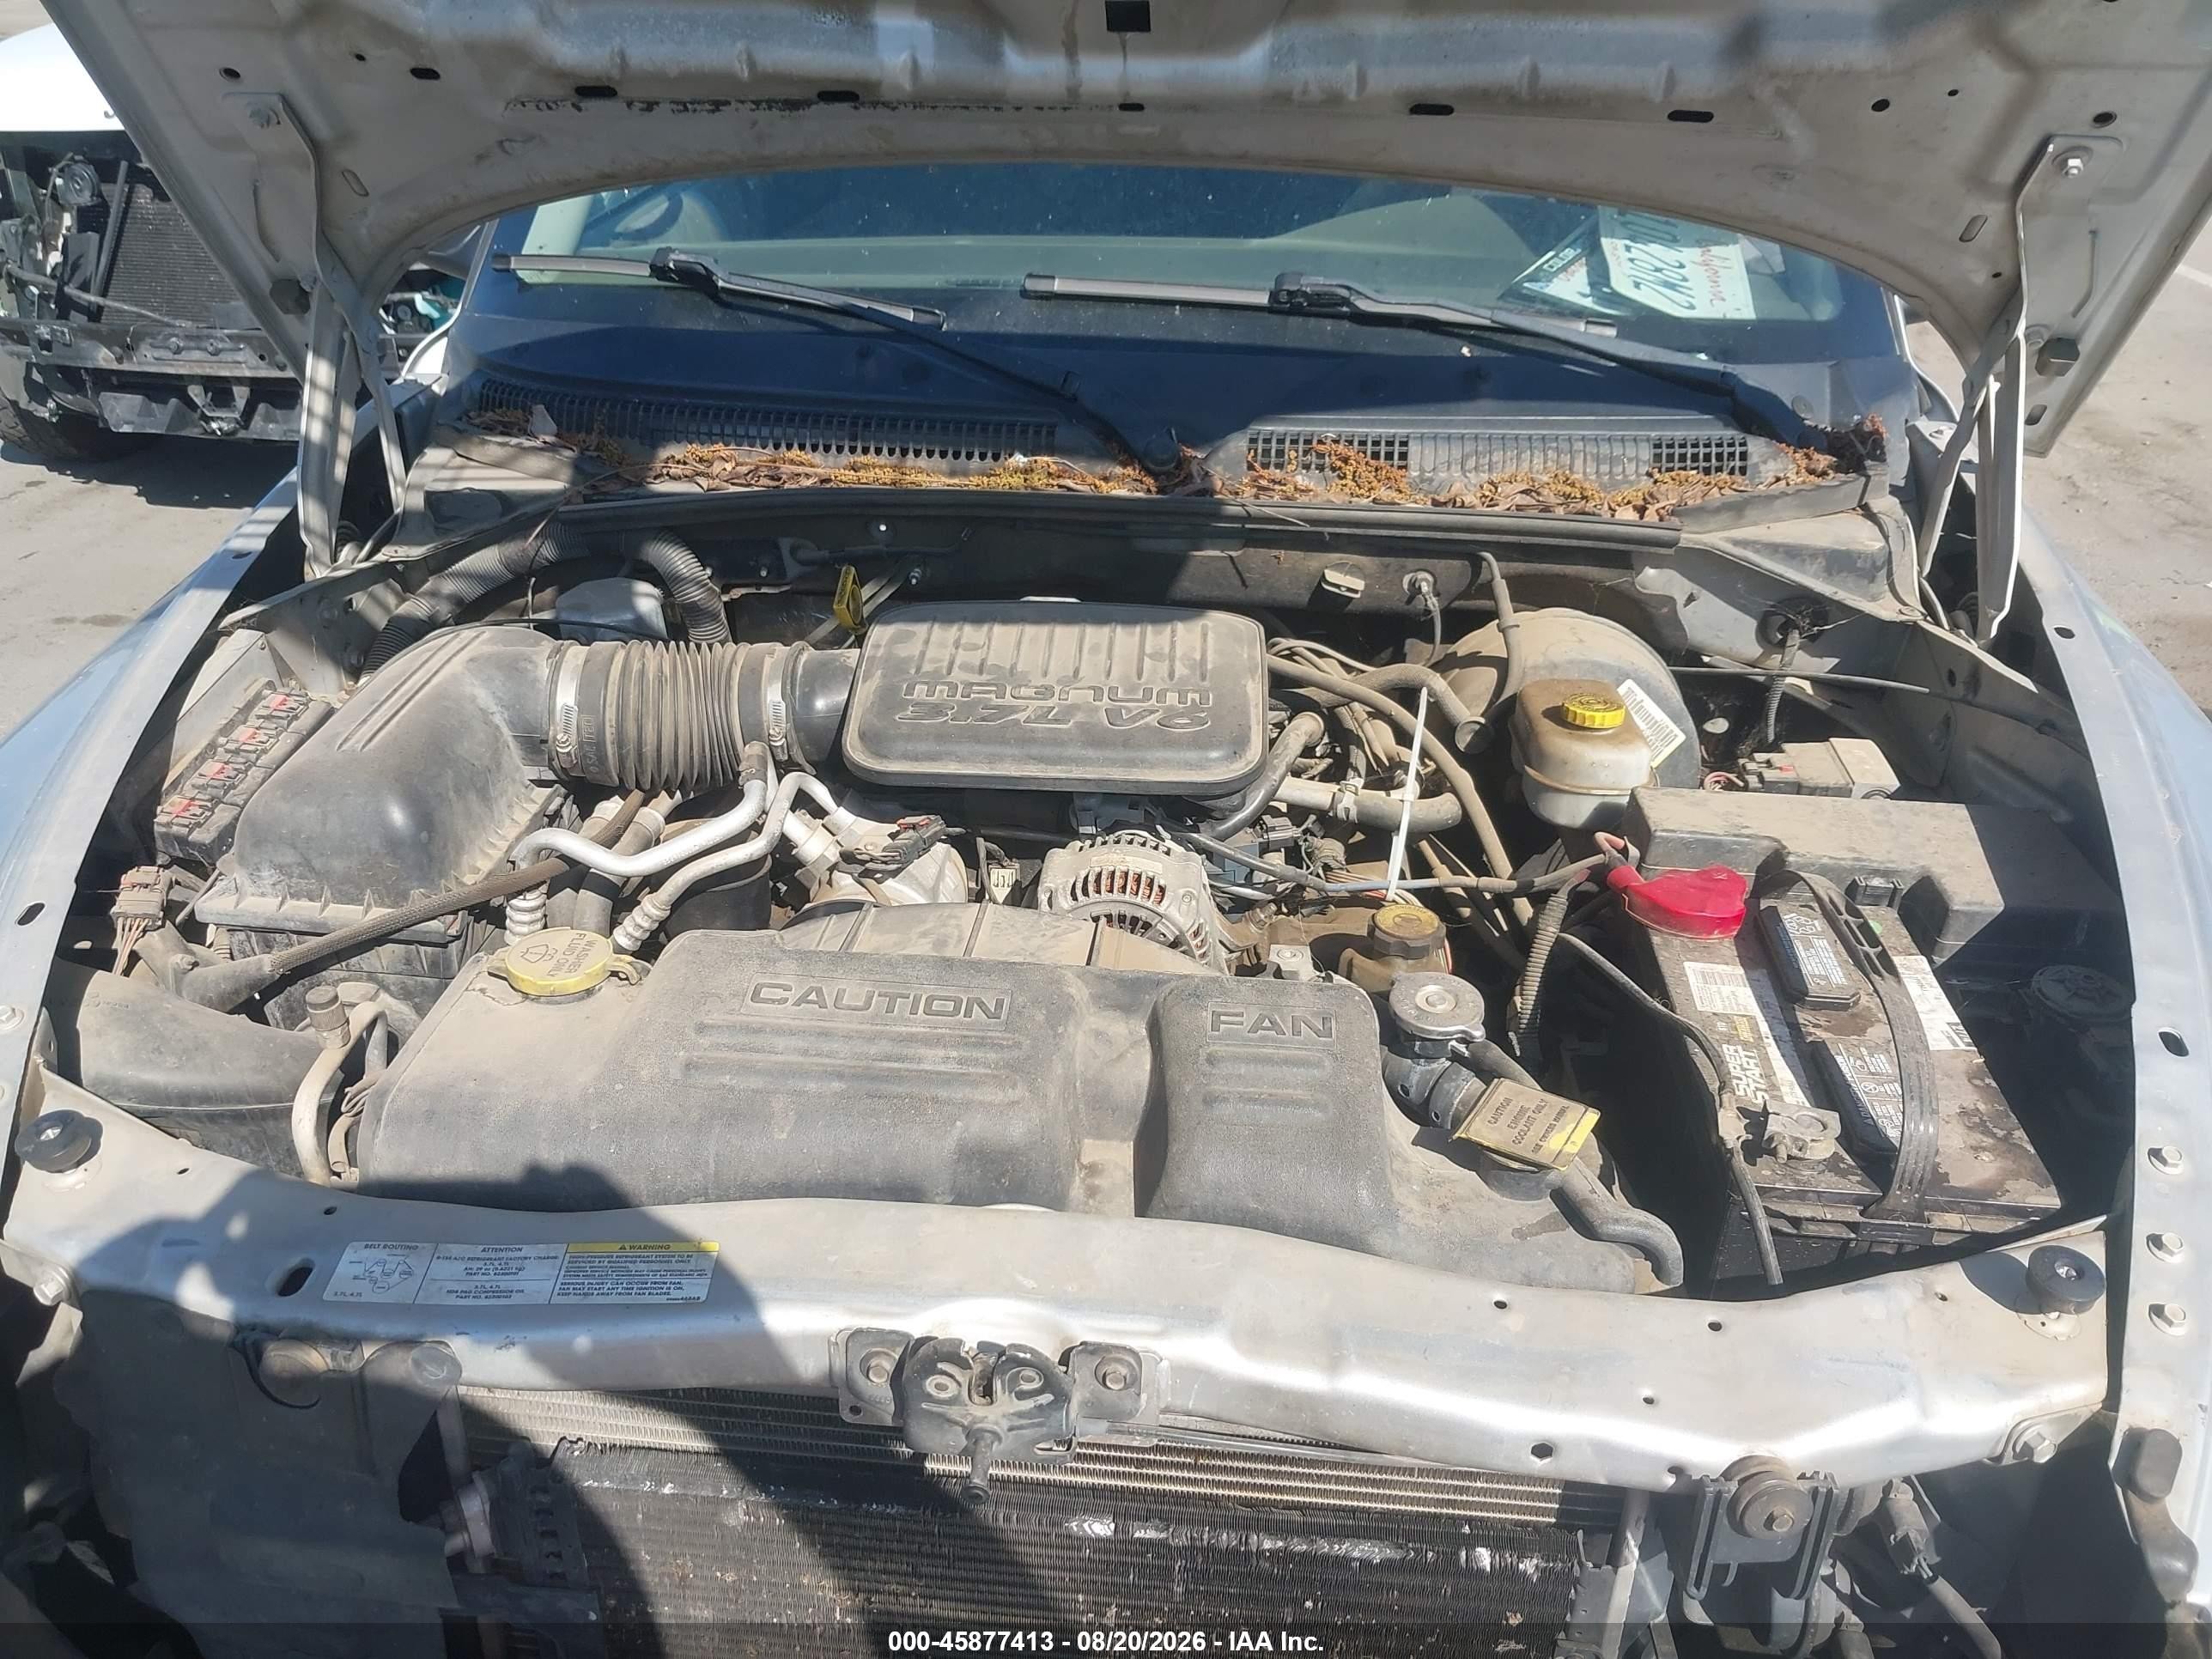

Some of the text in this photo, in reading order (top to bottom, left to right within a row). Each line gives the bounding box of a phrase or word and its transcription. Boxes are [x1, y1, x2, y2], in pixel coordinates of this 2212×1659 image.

[902, 680, 1212, 707] MAGNUM
[896, 701, 1212, 731] 3.7L V6
[546, 933, 587, 977] FLUID ONLY
[564, 939, 599, 974] WASHER
[750, 981, 1006, 1020] CAUTION
[1209, 1010, 1334, 1039] FAN
[1722, 1043, 1750, 1097] SUPER
[1741, 1049, 1770, 1104] START
[1486, 1097, 1513, 1125] CAUTION
[1506, 1104, 1530, 1129] ENGINE
[1510, 1098, 1548, 1146] COOLANT ONLY
